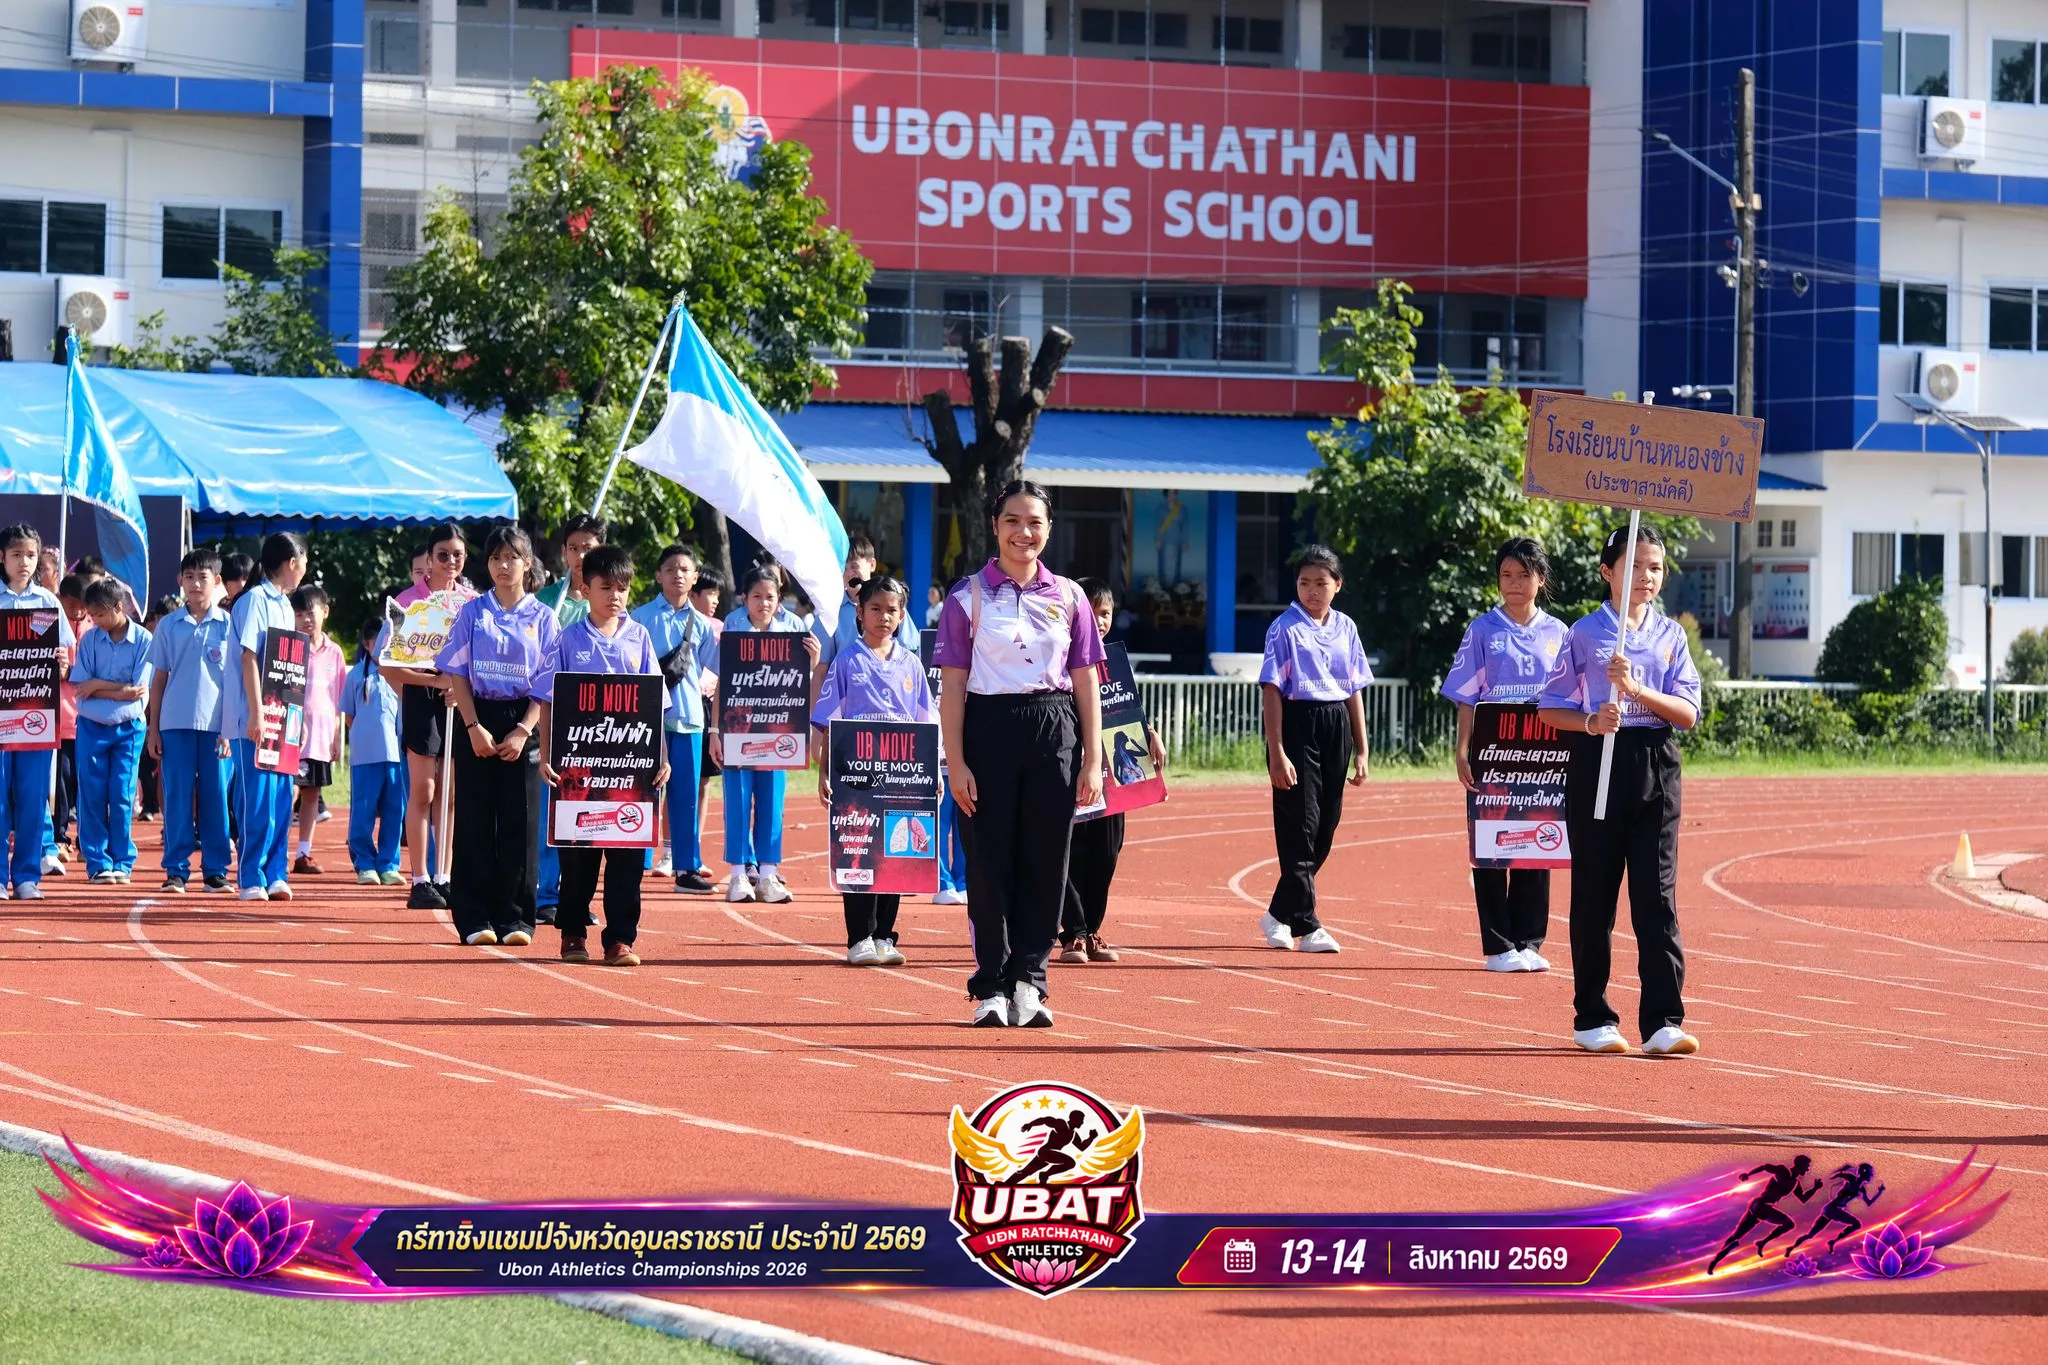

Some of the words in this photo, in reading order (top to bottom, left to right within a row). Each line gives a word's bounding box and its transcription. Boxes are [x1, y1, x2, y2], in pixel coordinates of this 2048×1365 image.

[852, 104, 1417, 182] UBONRATCHATHANI
[918, 177, 1132, 235] SPORTS
[1164, 188, 1373, 247] SCHOOL
[1547, 415, 1745, 477] โรงเรียนบ้านหนองช้าง
[1585, 470, 1693, 503] (ประชาสามัคคี)
[740, 638, 755, 661] UB
[760, 638, 791, 661] MOVE
[1516, 654, 1535, 676] 13
[731, 664, 804, 694] บุหรี่ไฟฟ้า
[579, 682, 597, 712] UB
[603, 683, 640, 713] MOVE
[727, 693, 806, 707] ทำลายความมั่นคง
[745, 712, 790, 724] ของชาติ
[1498, 712, 1516, 740] UB
[567, 715, 653, 752] บุหรี่ไฟฟ้า
[856, 731, 873, 760] UB
[880, 732, 916, 761] MOVE
[561, 751, 654, 769] ทำลายความมั่นคง
[847, 760, 872, 771] YOU
[874, 762, 888, 772] BE
[890, 762, 924, 773] MOVE
[582, 775, 635, 790] ของชาติ
[840, 775, 867, 786] ชาวอุบล
[832, 810, 880, 831] บุหรี่ไฟฟ้า
[839, 833, 873, 843] ส่งผลเสีย
[843, 845, 868, 855] ต่อปอด
